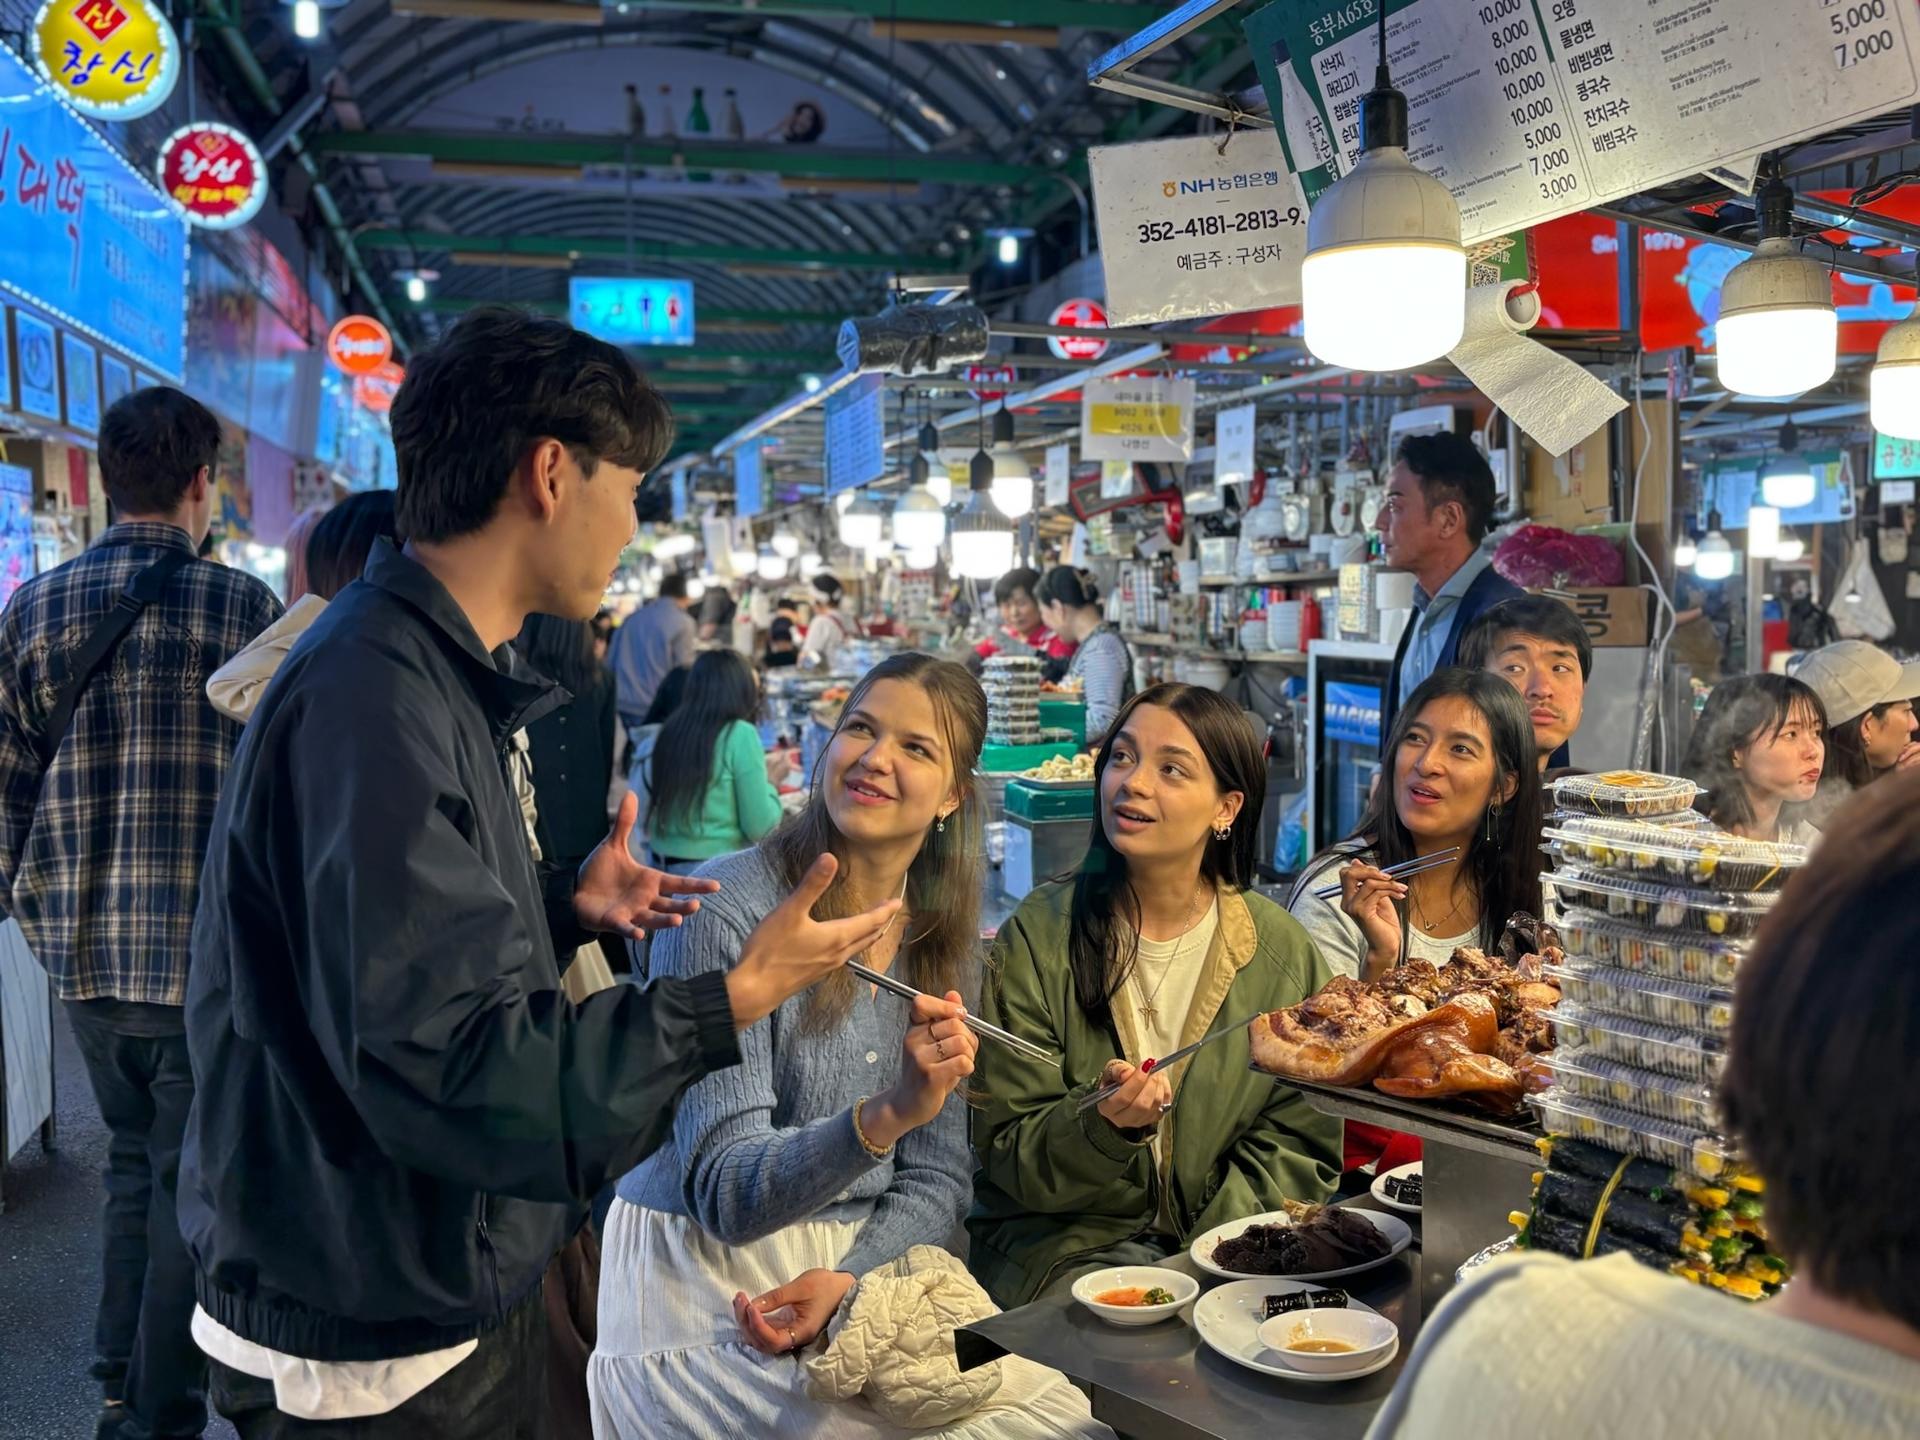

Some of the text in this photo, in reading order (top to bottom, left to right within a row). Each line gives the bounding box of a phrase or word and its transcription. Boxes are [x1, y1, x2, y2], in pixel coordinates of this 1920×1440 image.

[1308, 0, 1378, 46] 동부A65호
[1479, 0, 1521, 25] 10,000
[1552, 0, 1576, 22] 오뎅
[1830, 0, 1885, 34] 5,000
[1491, 19, 1529, 49] 8,000
[1560, 19, 1596, 49] 물냉면
[1834, 29, 1893, 67] 7,000
[62, 40, 155, 85] 창신
[1320, 50, 1345, 77] 산낙지
[1494, 45, 1537, 76] 10,000
[1567, 41, 1615, 74] 비빔냉면
[1326, 70, 1360, 98] 머리고기
[1502, 71, 1545, 101] 10,000
[1576, 75, 1611, 102] 콩국수
[1511, 97, 1553, 127] 10,000
[1584, 98, 1631, 128] 잔치국수
[1342, 121, 1361, 144] 순대
[1524, 122, 1561, 150] 5,000
[1592, 124, 1639, 153] 비빔국수
[1312, 115, 1338, 181] 국순당
[1529, 148, 1569, 176] 7,000
[1539, 173, 1577, 199] 3,000
[1138, 207, 1306, 243] 352-4181-2813-9
[1177, 251, 1223, 271] 예금주
[1236, 244, 1282, 265] 구성자
